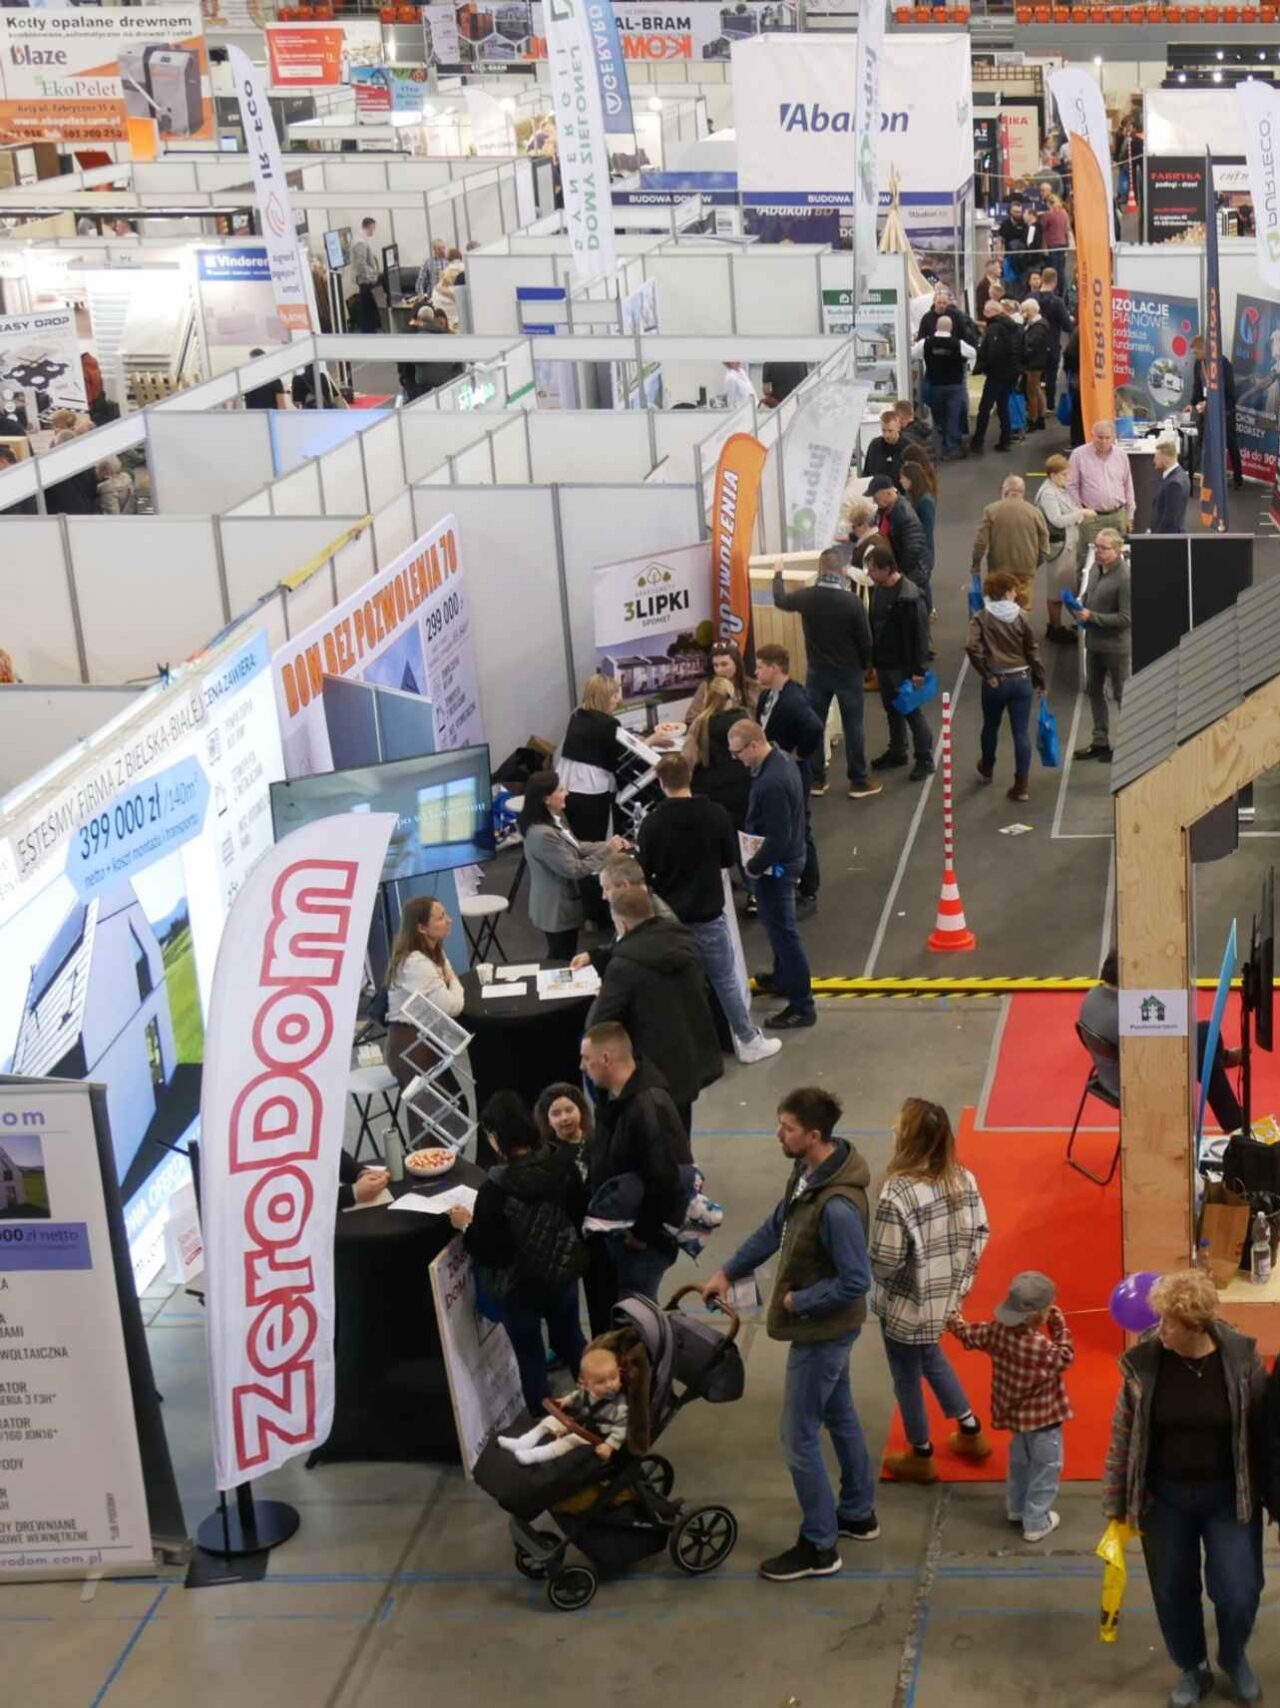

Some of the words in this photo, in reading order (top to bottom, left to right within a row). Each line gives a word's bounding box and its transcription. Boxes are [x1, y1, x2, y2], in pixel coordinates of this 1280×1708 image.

[51, 16, 114, 31] opalane
[119, 14, 192, 28] drewnem
[615, 16, 691, 30] AL-BRAM
[784, 103, 909, 133] Abaon
[628, 194, 671, 204] BUDOWA
[1112, 298, 1170, 316] IZOLACJE
[1112, 310, 1170, 329] PIANOWE
[624, 589, 690, 621] 3LIPKI
[281, 641, 325, 719] DOM
[323, 617, 356, 676] BEZ
[353, 544, 443, 660] POZWOLENIA
[79, 812, 111, 860] 399
[114, 794, 145, 841] 000
[40, 1230, 80, 1242] netto
[0, 1458, 24, 1471] ODY
